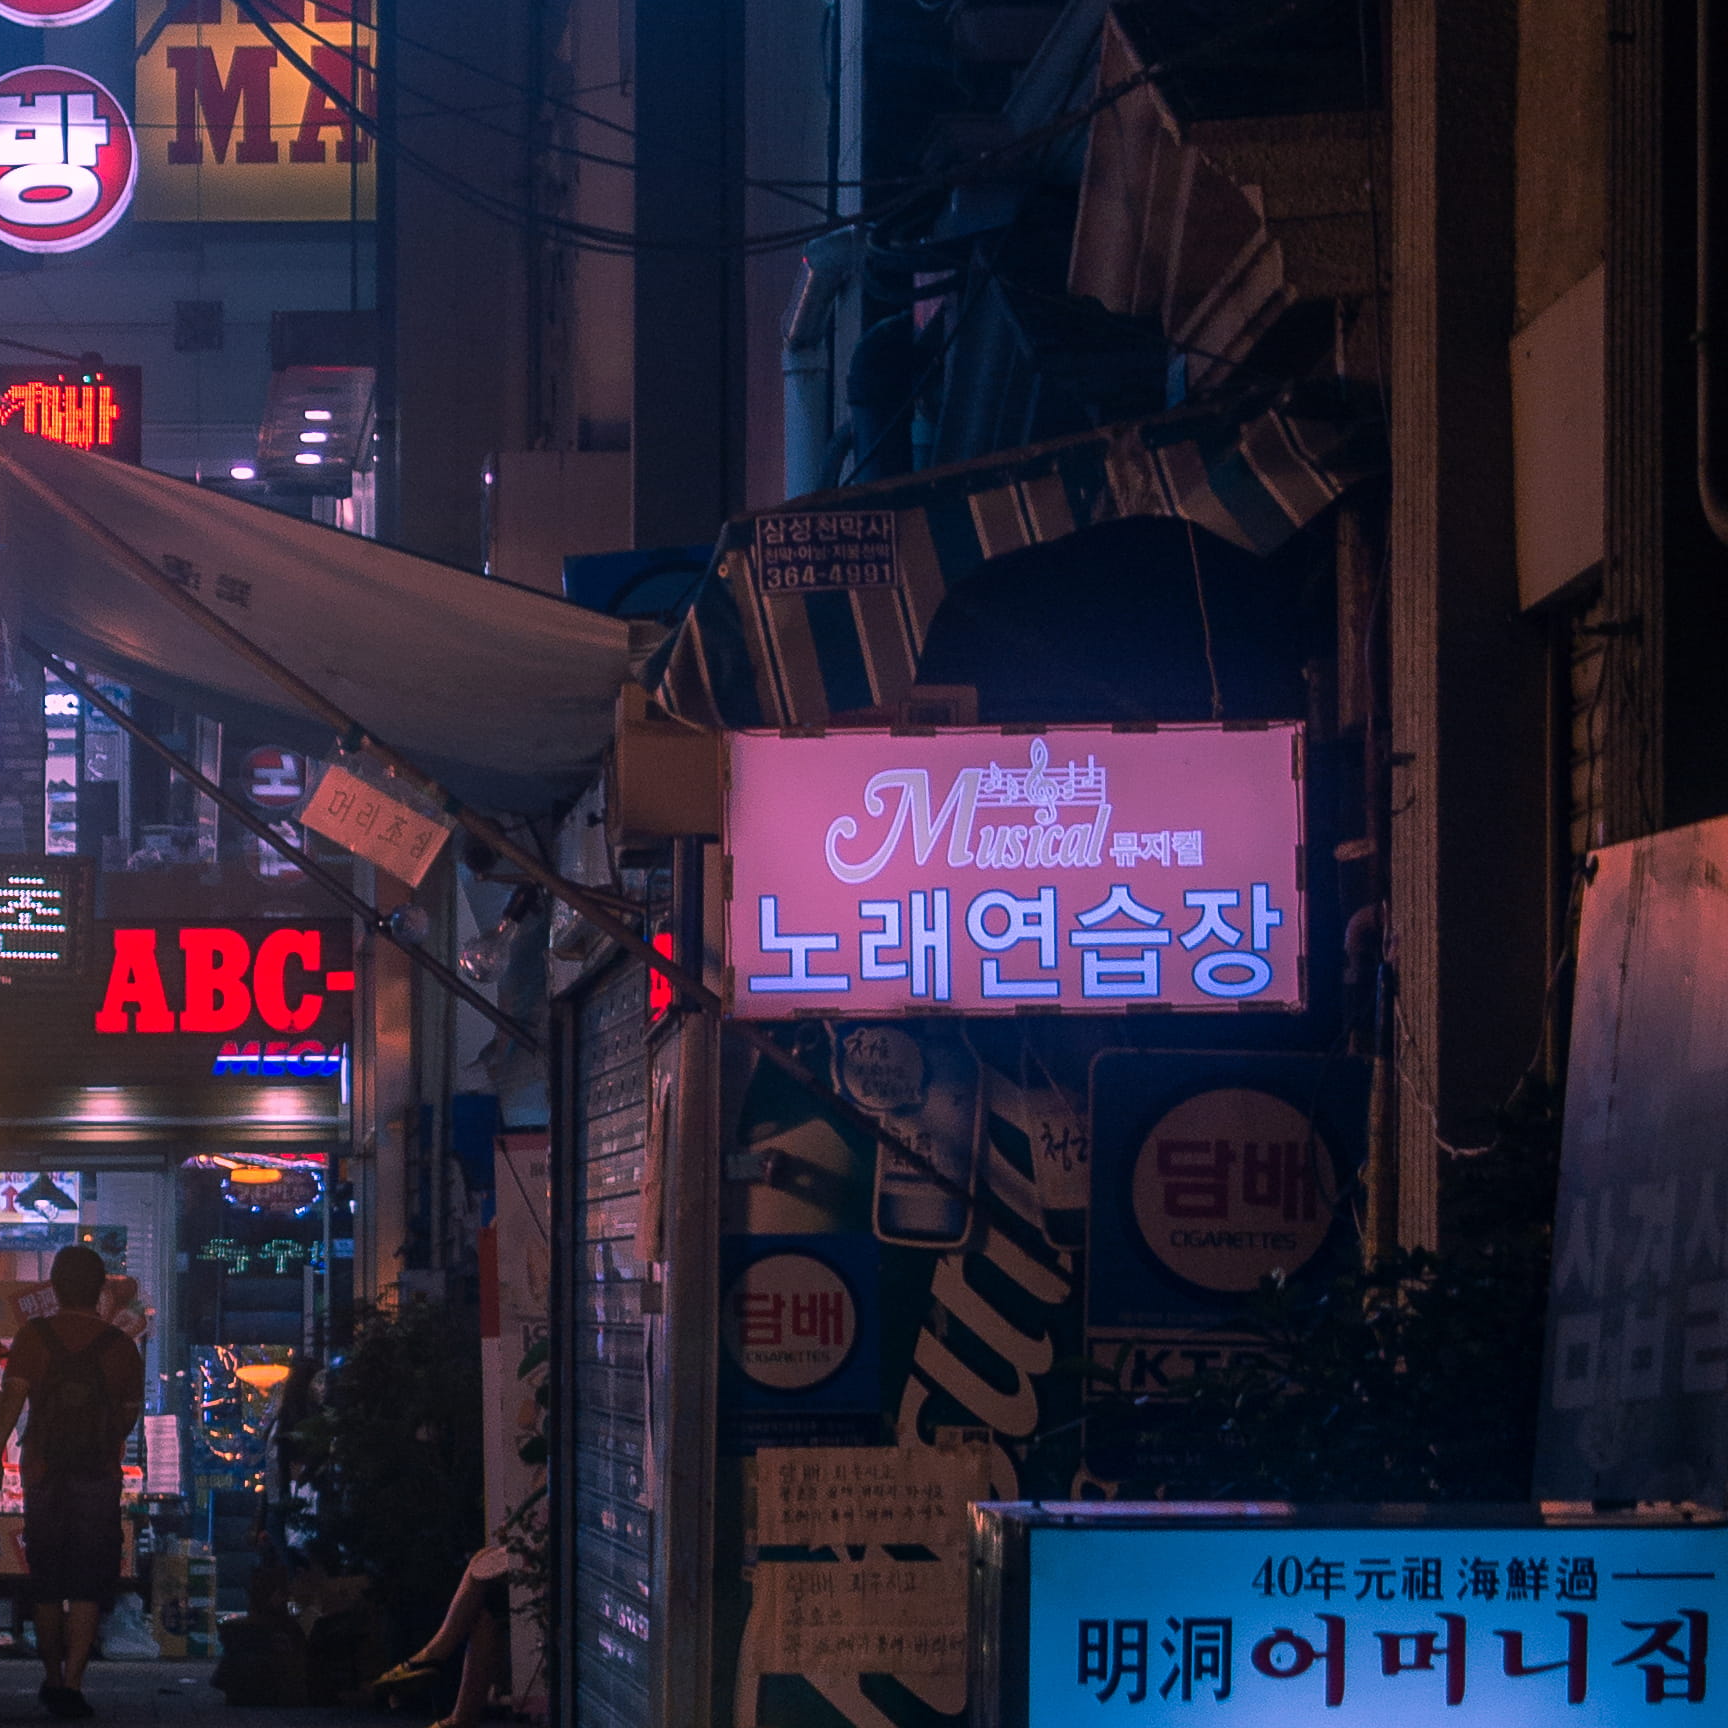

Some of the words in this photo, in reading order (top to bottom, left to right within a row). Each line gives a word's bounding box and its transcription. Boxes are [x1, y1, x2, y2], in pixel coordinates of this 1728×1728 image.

[825, 766, 1113, 885] Musical
[748, 882, 1283, 1002] 노래연습장
[1156, 1138, 1318, 1223] 담배
[1169, 1228, 1298, 1250] CIGARETTES
[735, 1292, 844, 1346] 담배
[1075, 1616, 1233, 1704] 明洞
[1250, 1610, 1710, 1708] 어머니집
